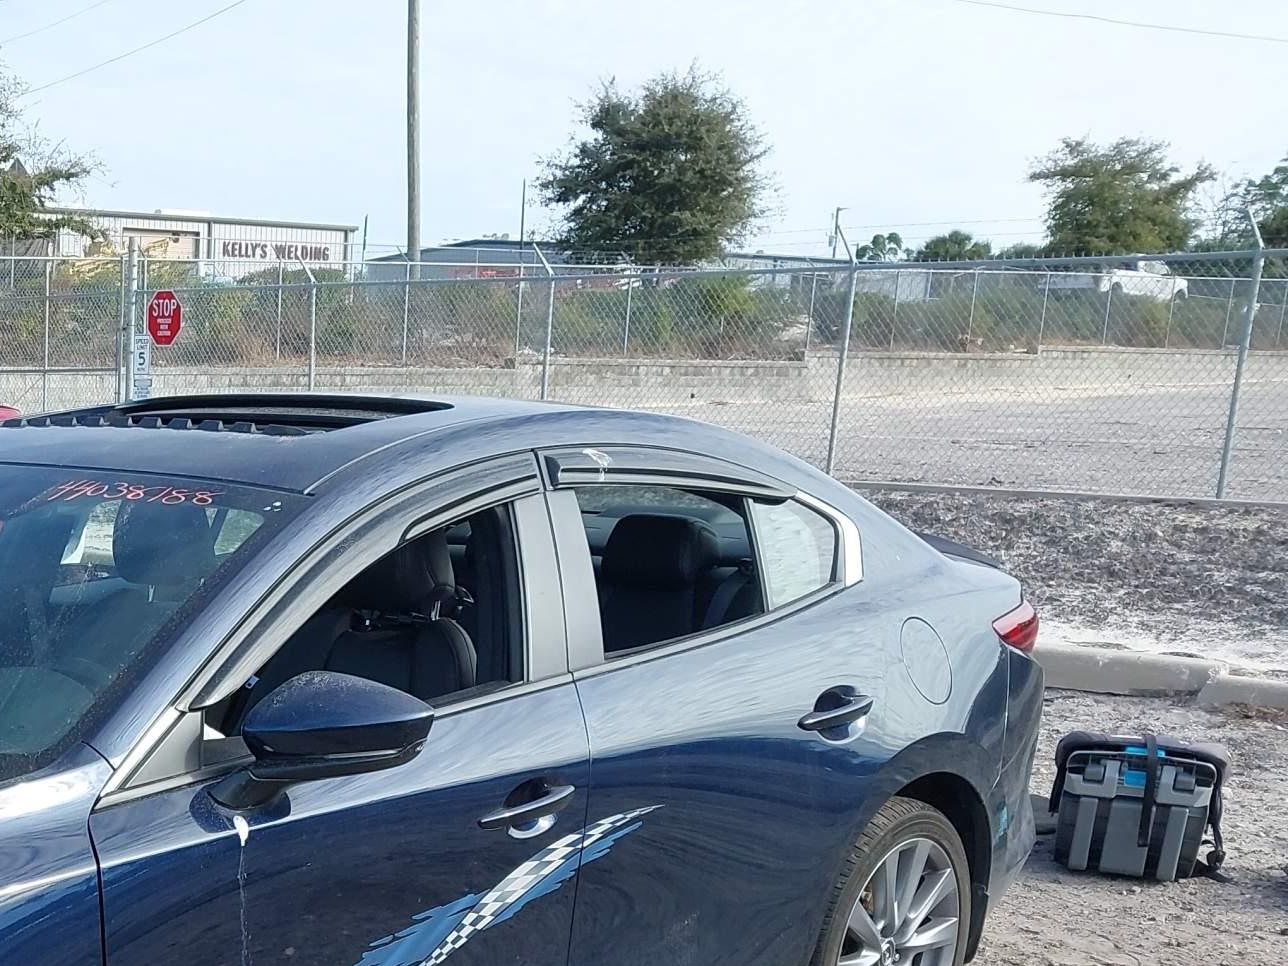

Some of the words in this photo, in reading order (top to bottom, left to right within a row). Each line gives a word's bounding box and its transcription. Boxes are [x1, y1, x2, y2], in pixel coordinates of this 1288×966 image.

[222, 241, 268, 259] KELLY'S
[274, 243, 330, 261] WELDING
[152, 299, 177, 317] STOP
[138, 352, 146, 366] 5
[48, 480, 225, 505] 44038188
